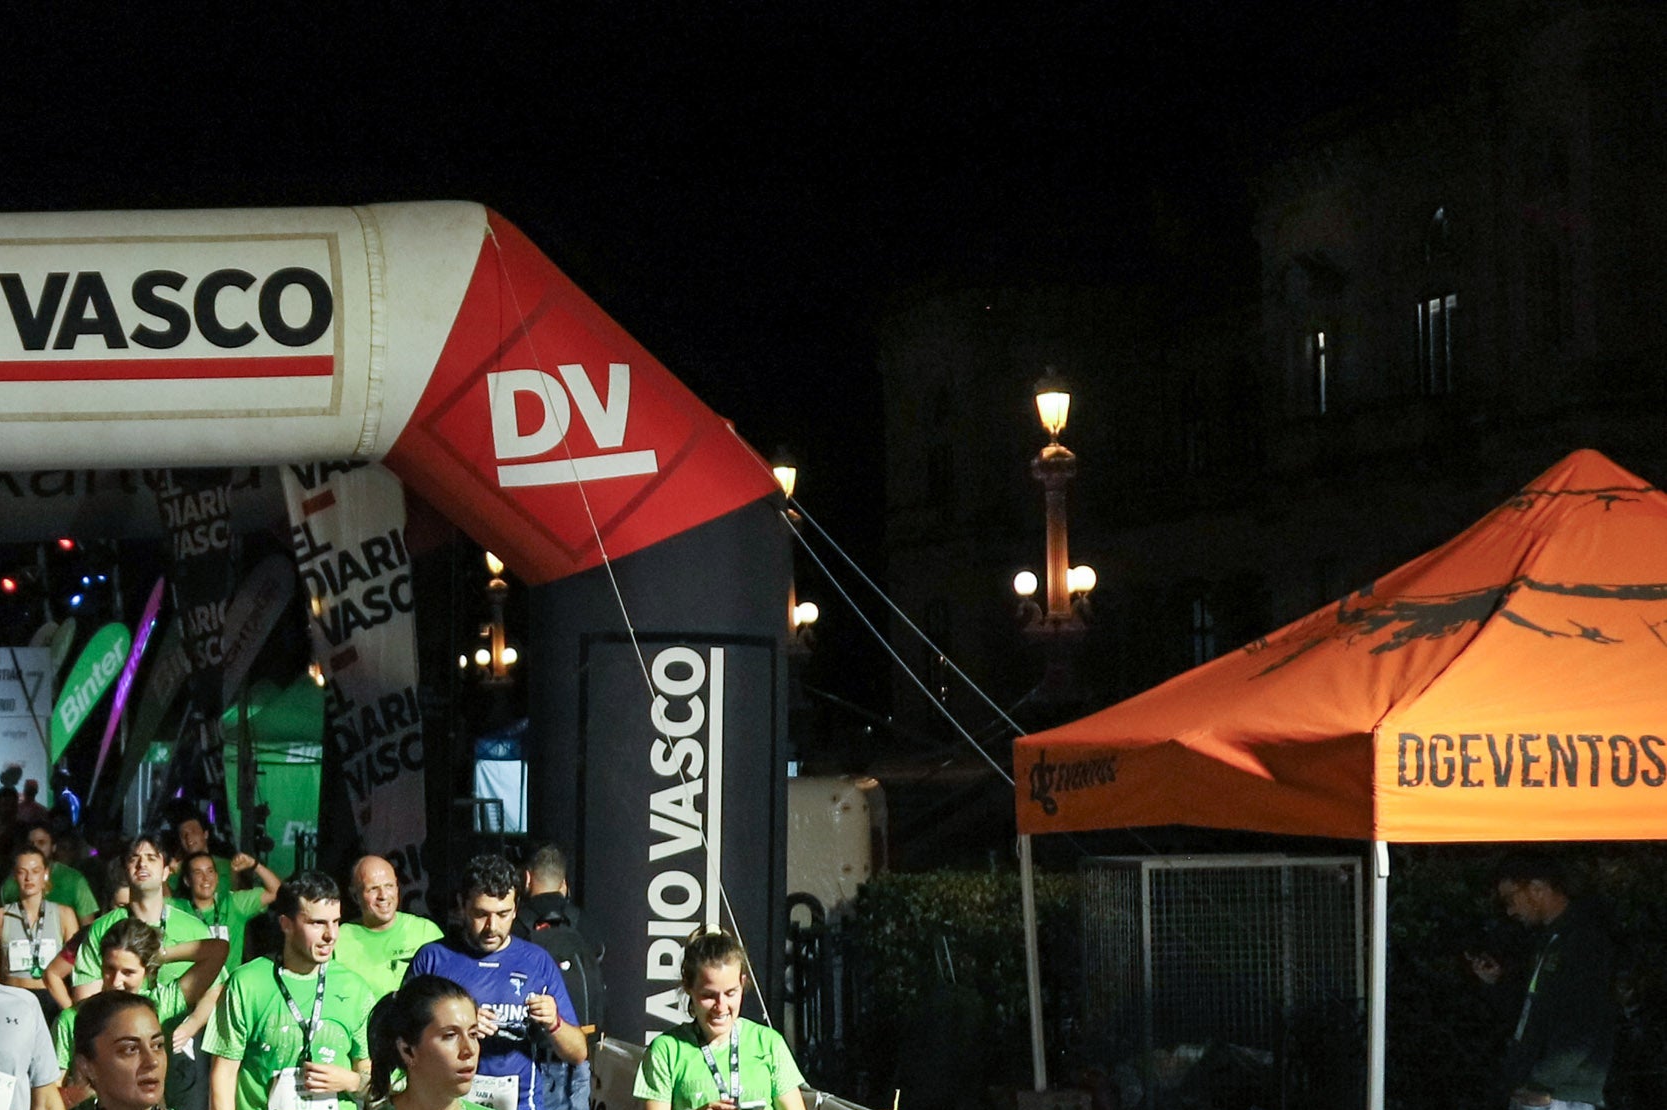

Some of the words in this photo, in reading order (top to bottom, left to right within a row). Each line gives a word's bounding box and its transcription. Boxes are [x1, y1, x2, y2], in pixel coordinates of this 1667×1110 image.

[487, 363, 630, 461] DV
[299, 528, 408, 599] DIARI
[312, 574, 414, 646] VASC
[60, 638, 127, 733] Binter
[649, 646, 707, 861] VASCO
